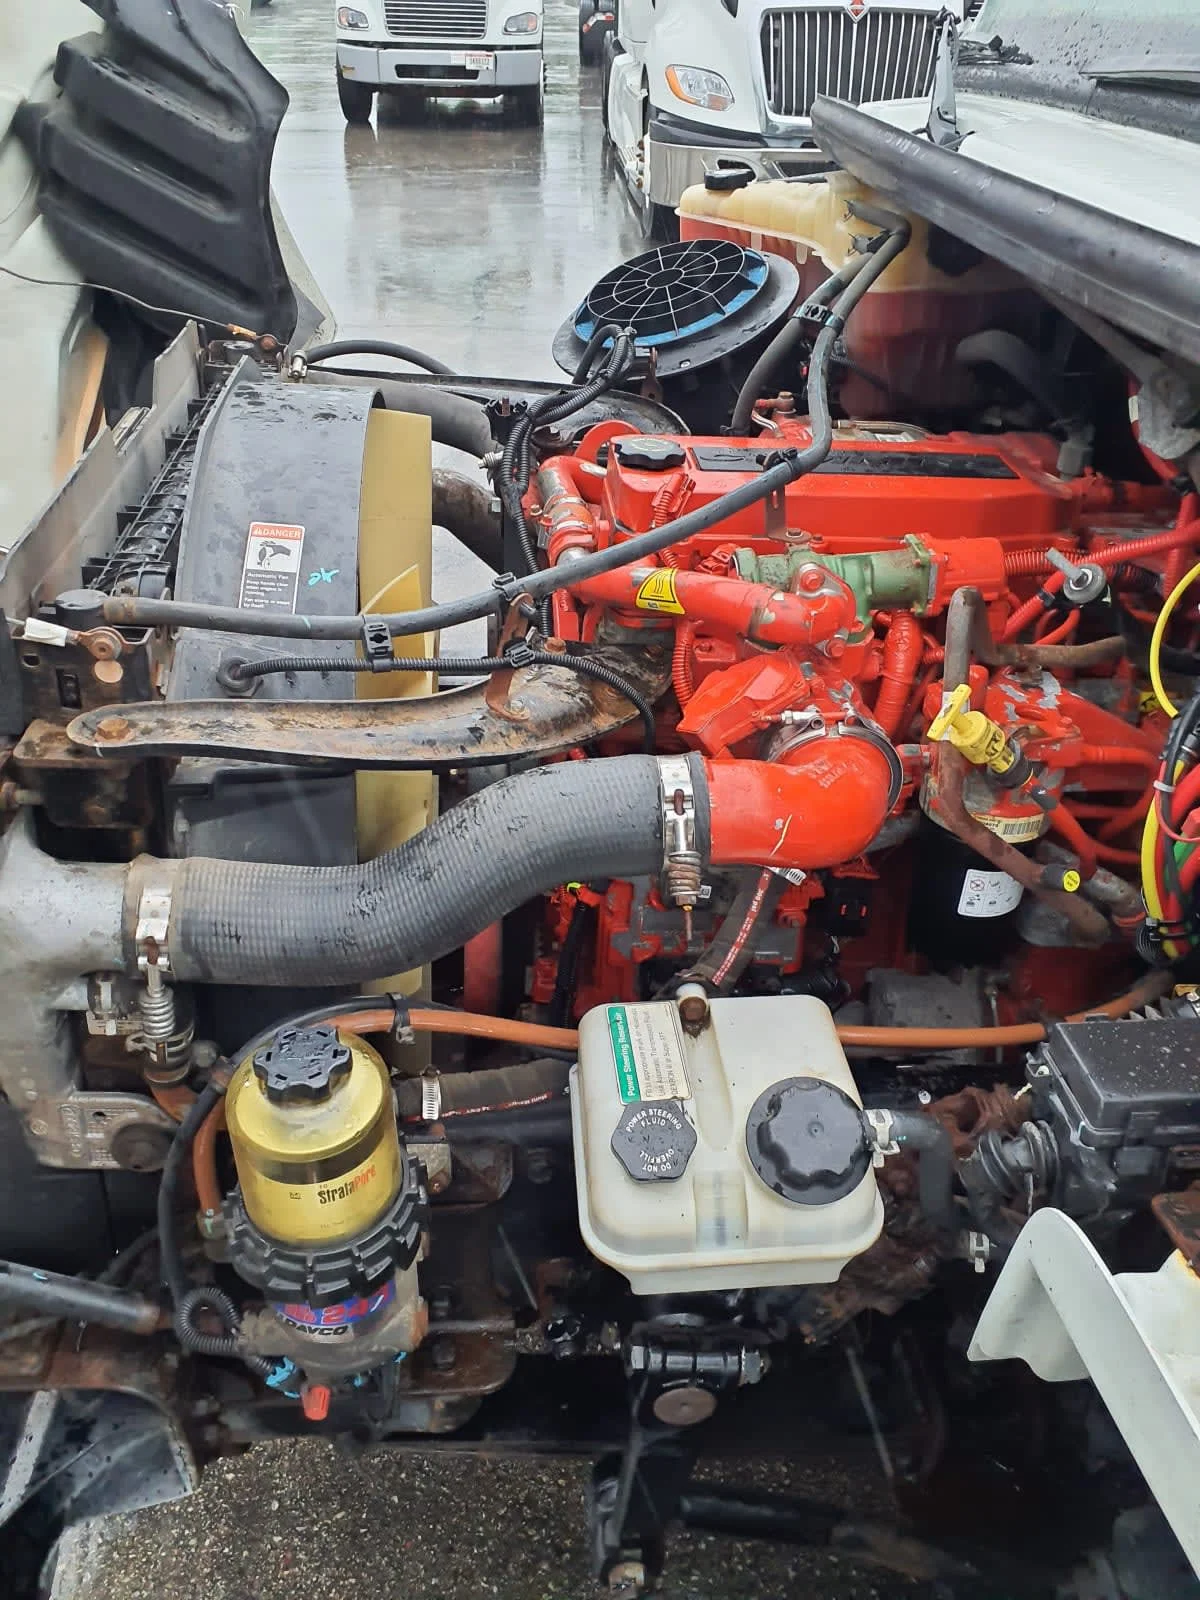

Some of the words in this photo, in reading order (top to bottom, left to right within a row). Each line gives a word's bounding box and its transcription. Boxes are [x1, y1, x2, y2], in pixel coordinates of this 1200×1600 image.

[262, 528, 301, 538] DANGER
[621, 1043, 632, 1072] Steering
[626, 1074, 636, 1096] Power
[625, 1110, 647, 1133] POWER
[648, 1108, 682, 1130] STEERING
[640, 1117, 666, 1128] FLUID
[639, 1148, 675, 1165] OVERFILL
[642, 1164, 658, 1173] NOT
[660, 1162, 672, 1173] DO
